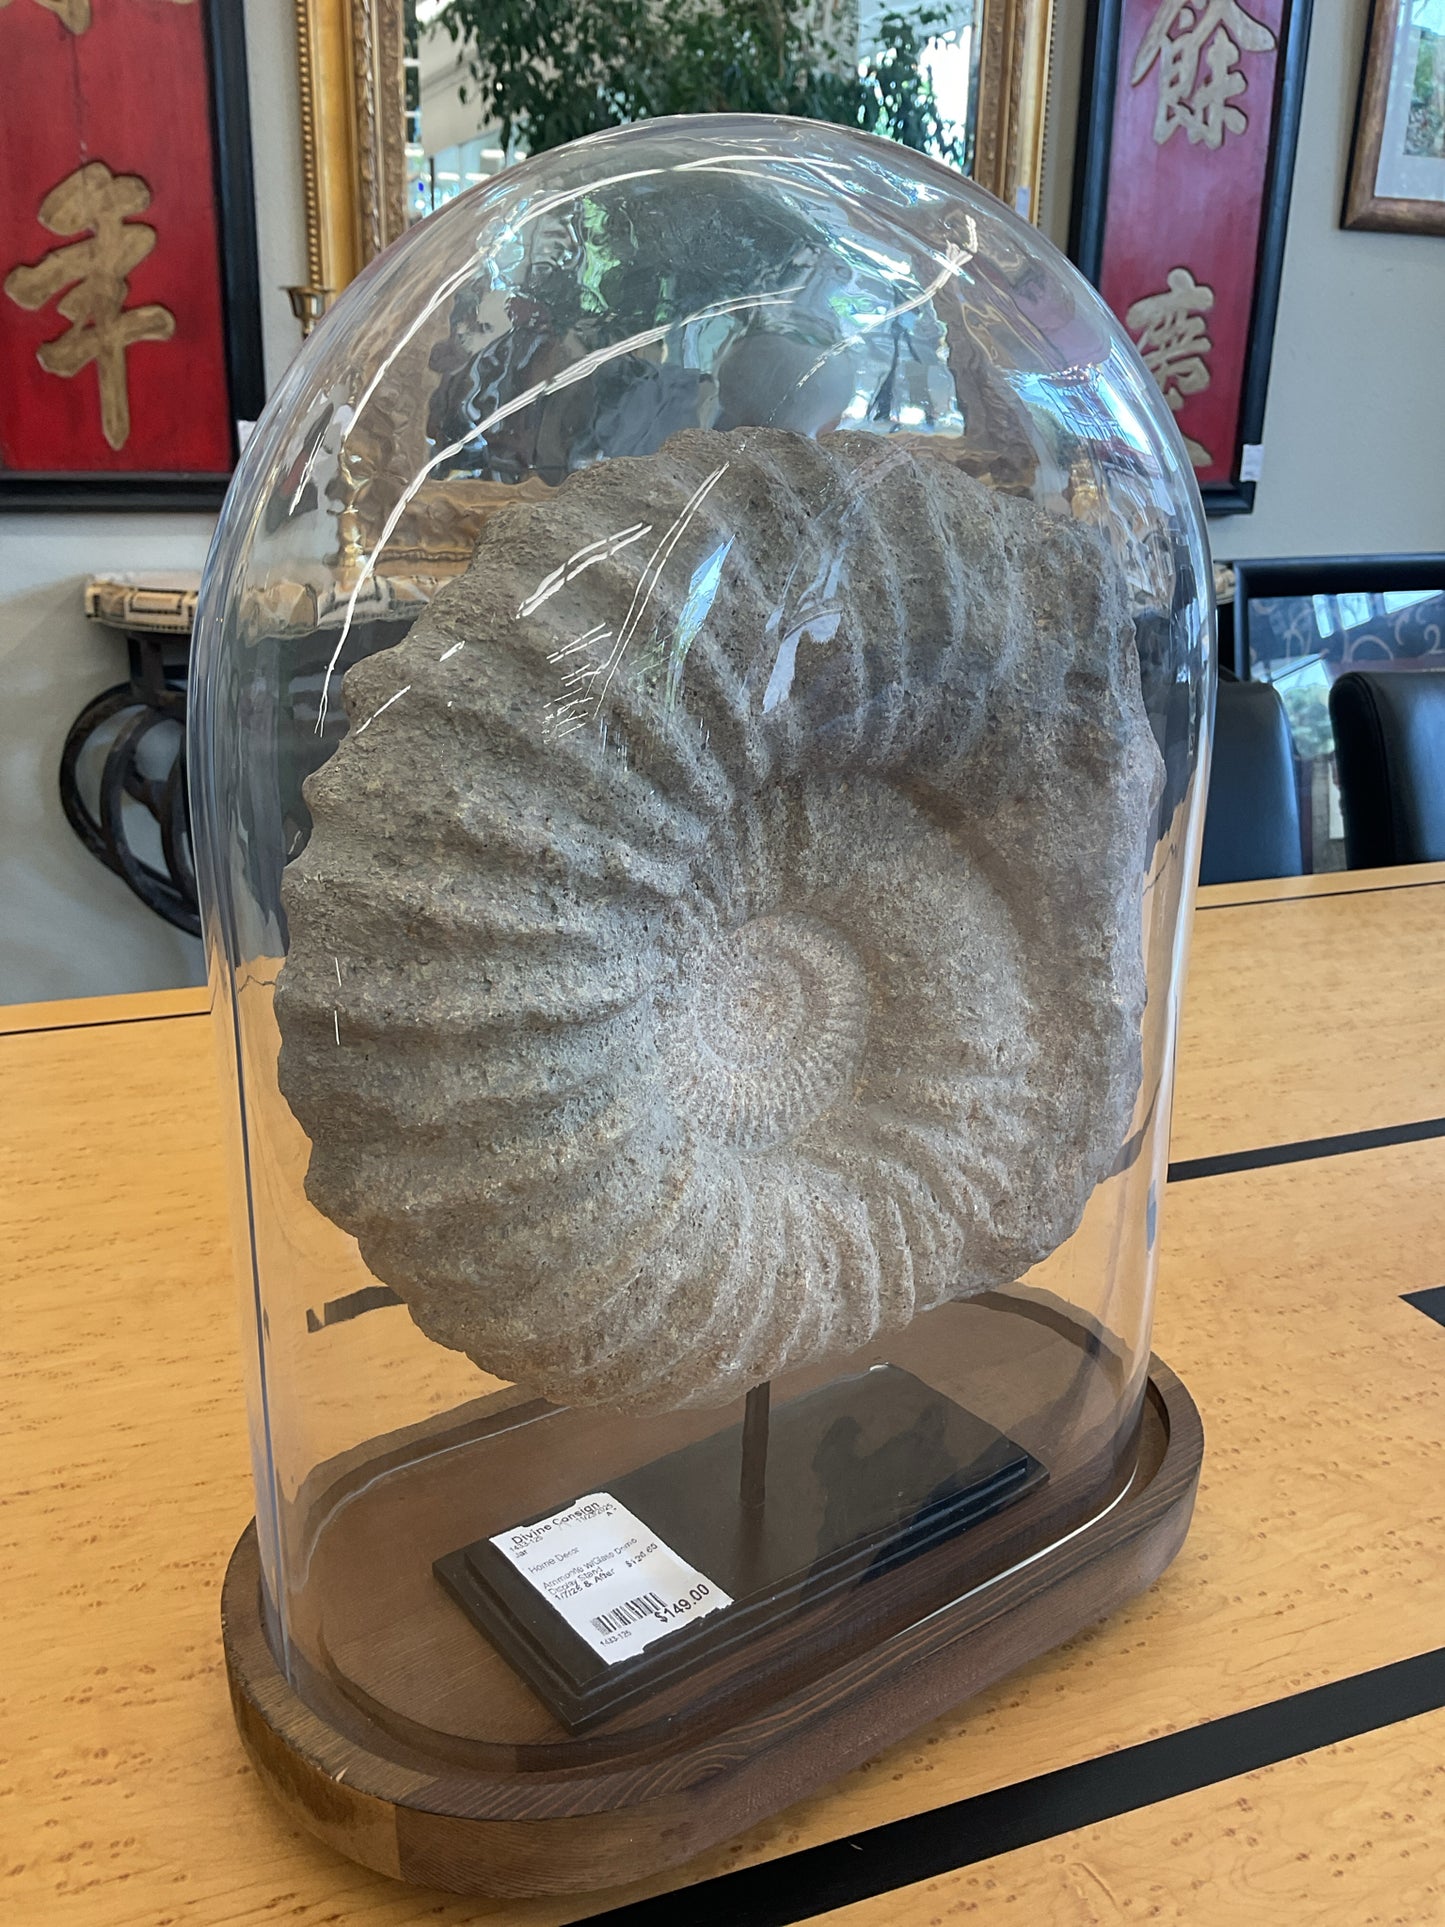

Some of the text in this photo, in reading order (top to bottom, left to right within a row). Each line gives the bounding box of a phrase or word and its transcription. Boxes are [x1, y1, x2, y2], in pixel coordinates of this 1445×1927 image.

[511, 1502, 600, 1545] Divine Consign
[528, 1558, 556, 1574] Home
[577, 1566, 604, 1582] Stand
[583, 1580, 592, 1588] &
[594, 1568, 615, 1584] After
[654, 1583, 710, 1623] $149.00
